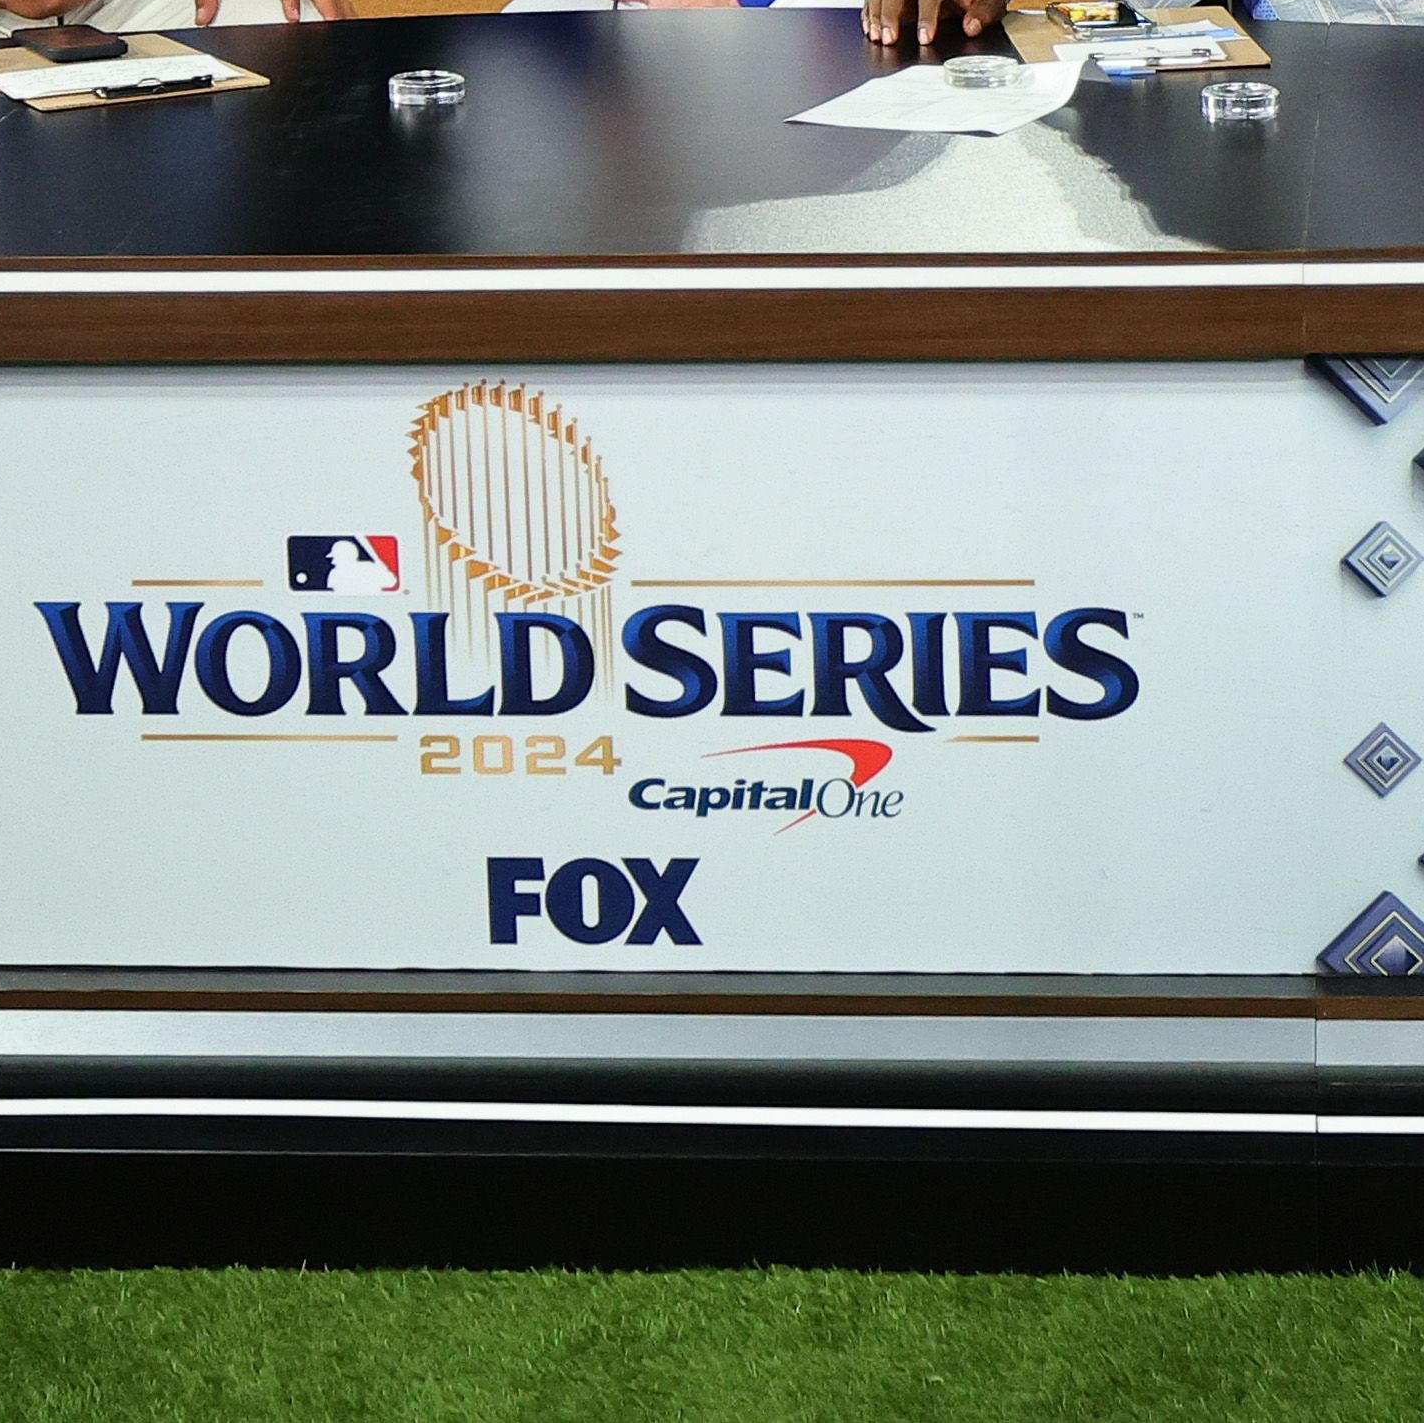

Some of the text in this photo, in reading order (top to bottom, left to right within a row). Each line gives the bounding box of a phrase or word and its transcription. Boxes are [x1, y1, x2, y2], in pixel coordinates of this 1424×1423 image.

[34, 602, 595, 717] WORLD
[622, 604, 1142, 733] SERIES
[420, 735, 622, 774] 2024
[487, 857, 703, 945] FOX
